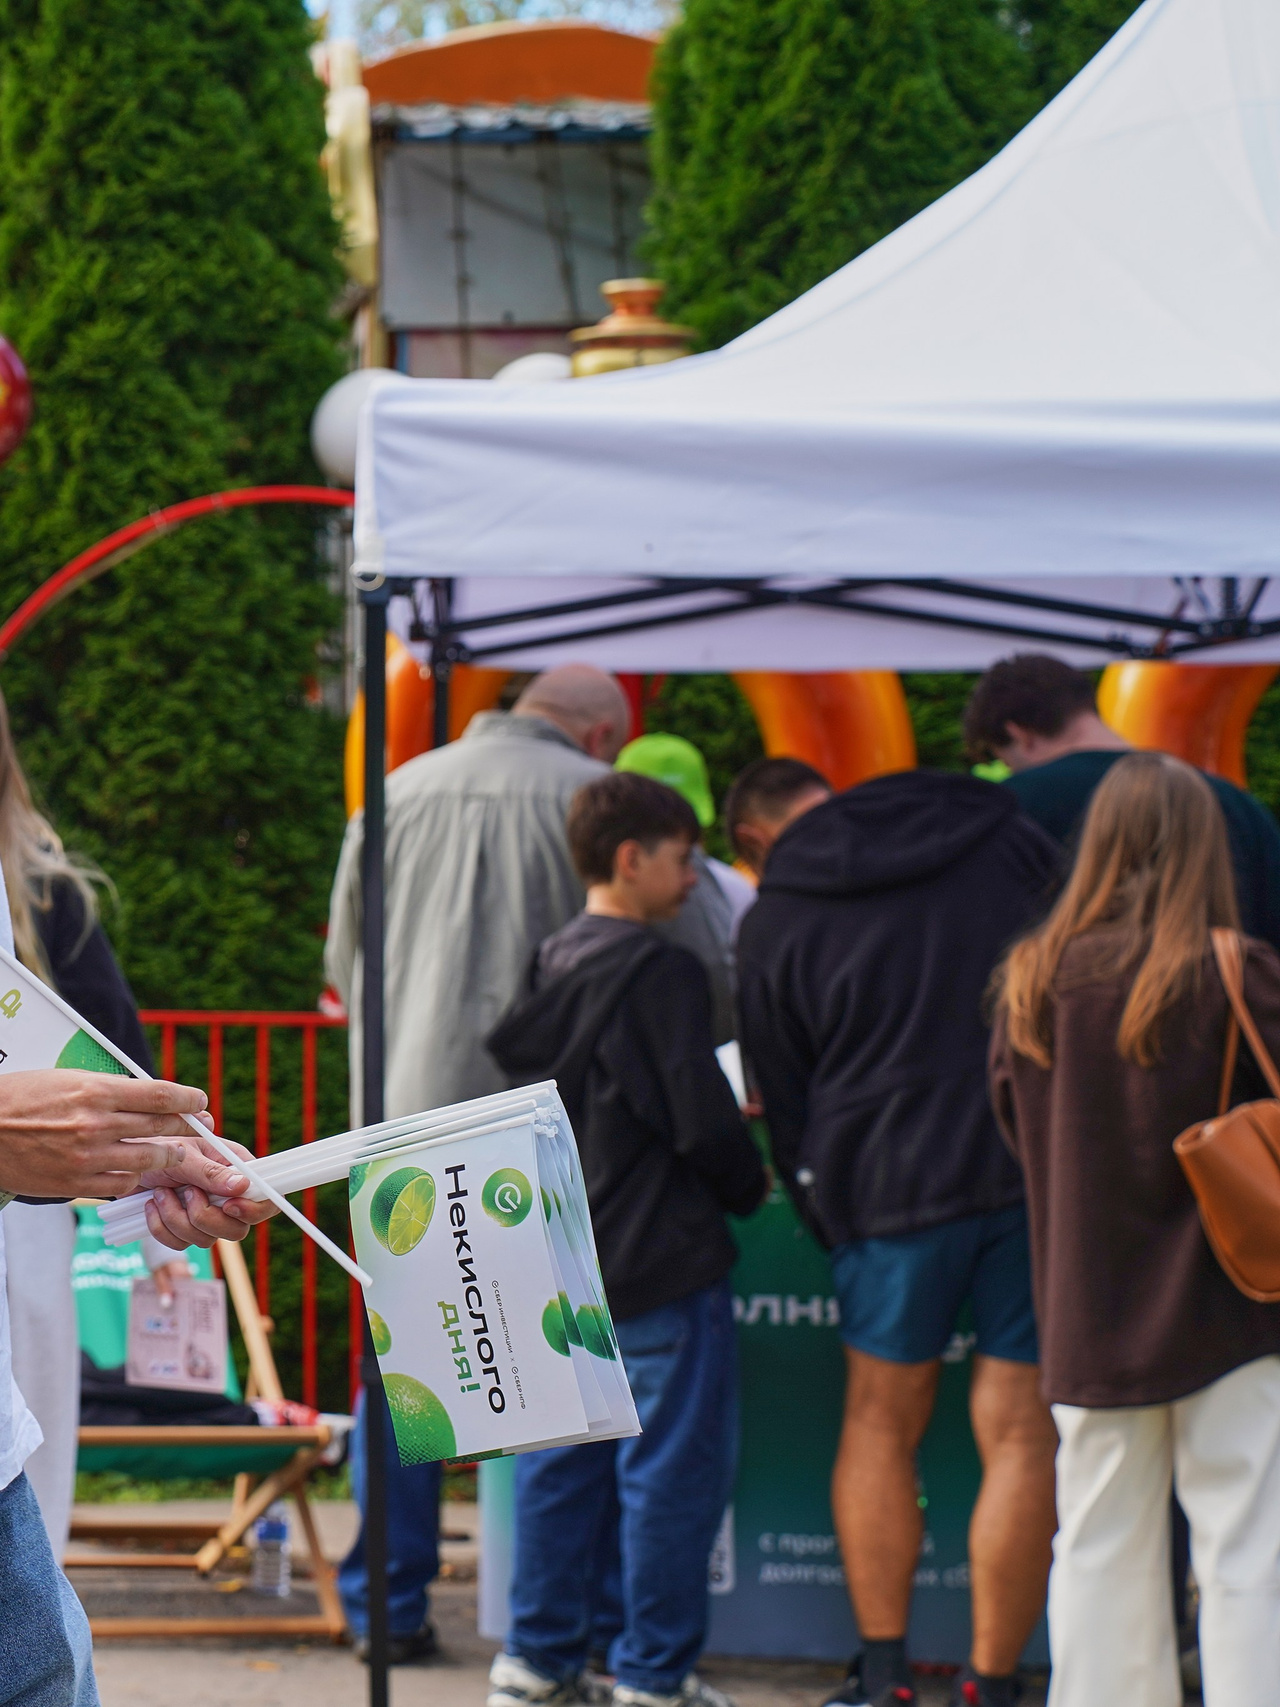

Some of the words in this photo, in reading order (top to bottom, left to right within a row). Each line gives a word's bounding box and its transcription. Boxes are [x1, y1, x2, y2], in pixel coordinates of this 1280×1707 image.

[445, 1163, 506, 1415] Некислого
[494, 1289, 503, 1307] СБЕР
[437, 1300, 481, 1394] дня!
[498, 1307, 513, 1353] ИНВЕСТИЦИИ
[514, 1375, 523, 1392] СБЕР
